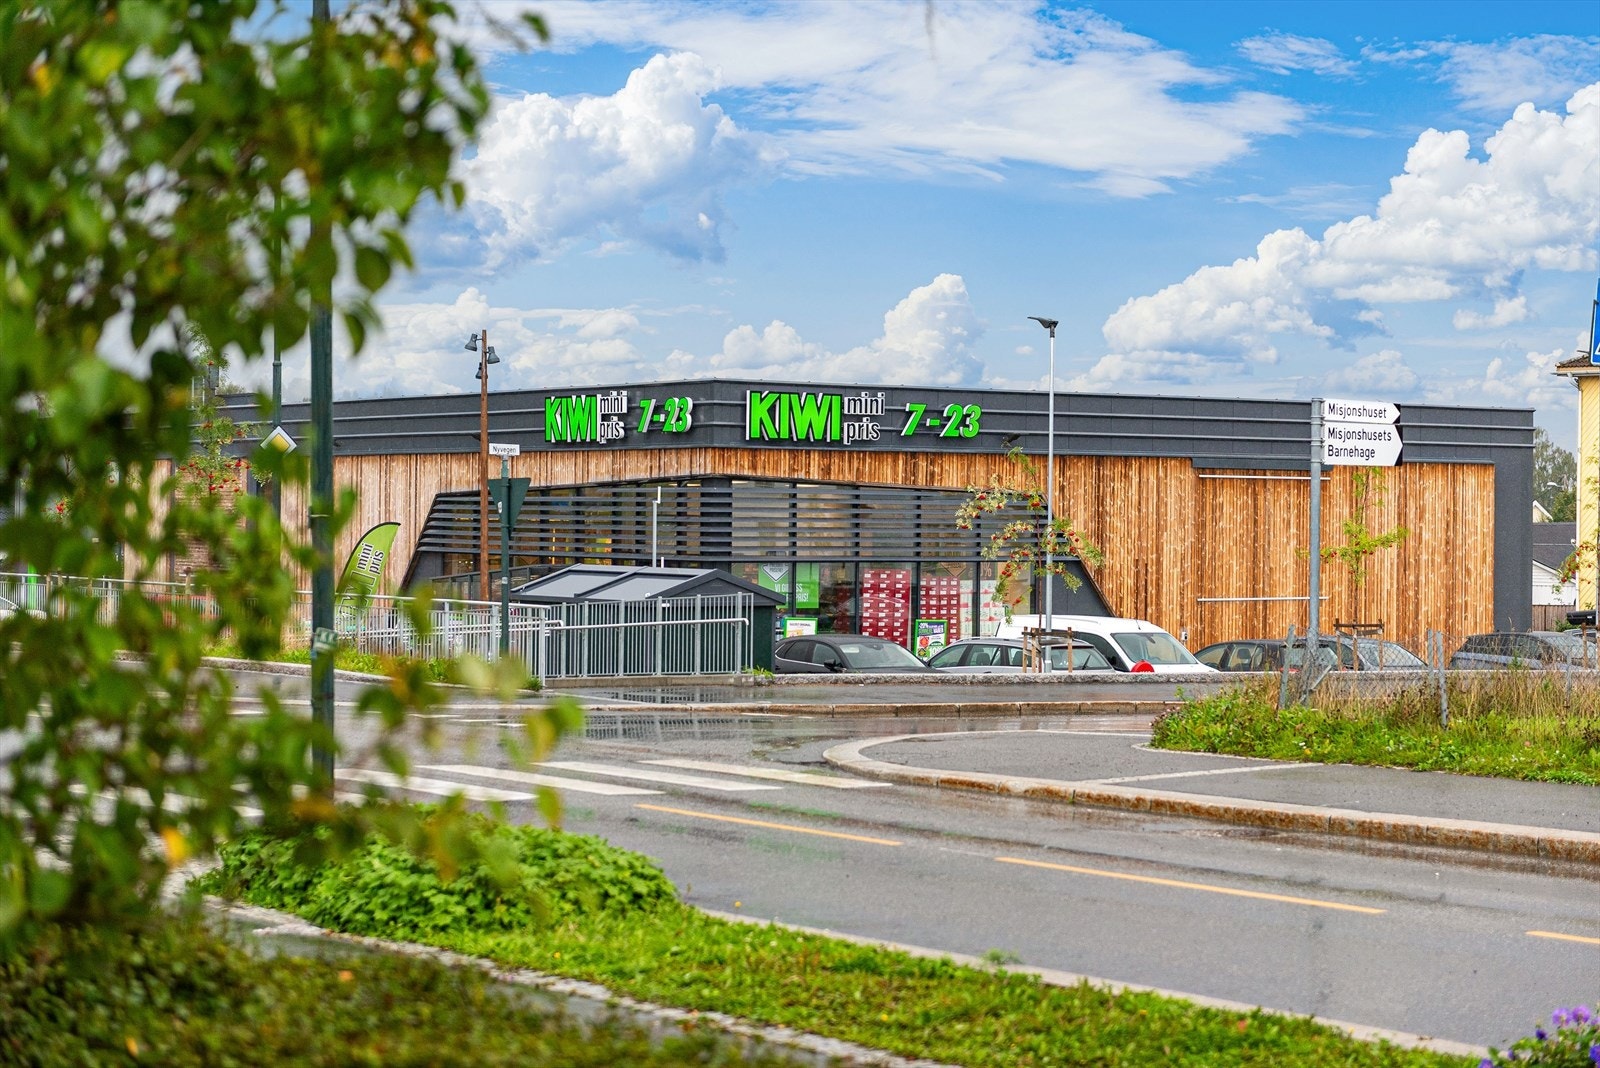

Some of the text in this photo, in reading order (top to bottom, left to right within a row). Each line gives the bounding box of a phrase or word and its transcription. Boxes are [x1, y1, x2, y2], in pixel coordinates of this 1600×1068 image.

[600, 390, 627, 413] mini
[844, 392, 885, 415] mini
[1328, 403, 1387, 419] Misjonshuset
[545, 395, 600, 443] KIWI
[746, 390, 843, 442] KIWI
[600, 416, 625, 444] pris
[843, 417, 880, 445] pris
[1328, 427, 1392, 443] Misjonshusets
[492, 445, 517, 455] Nyvegen
[1328, 445, 1376, 461] Barnehage
[356, 542, 373, 570] mini
[368, 550, 384, 575] pris
